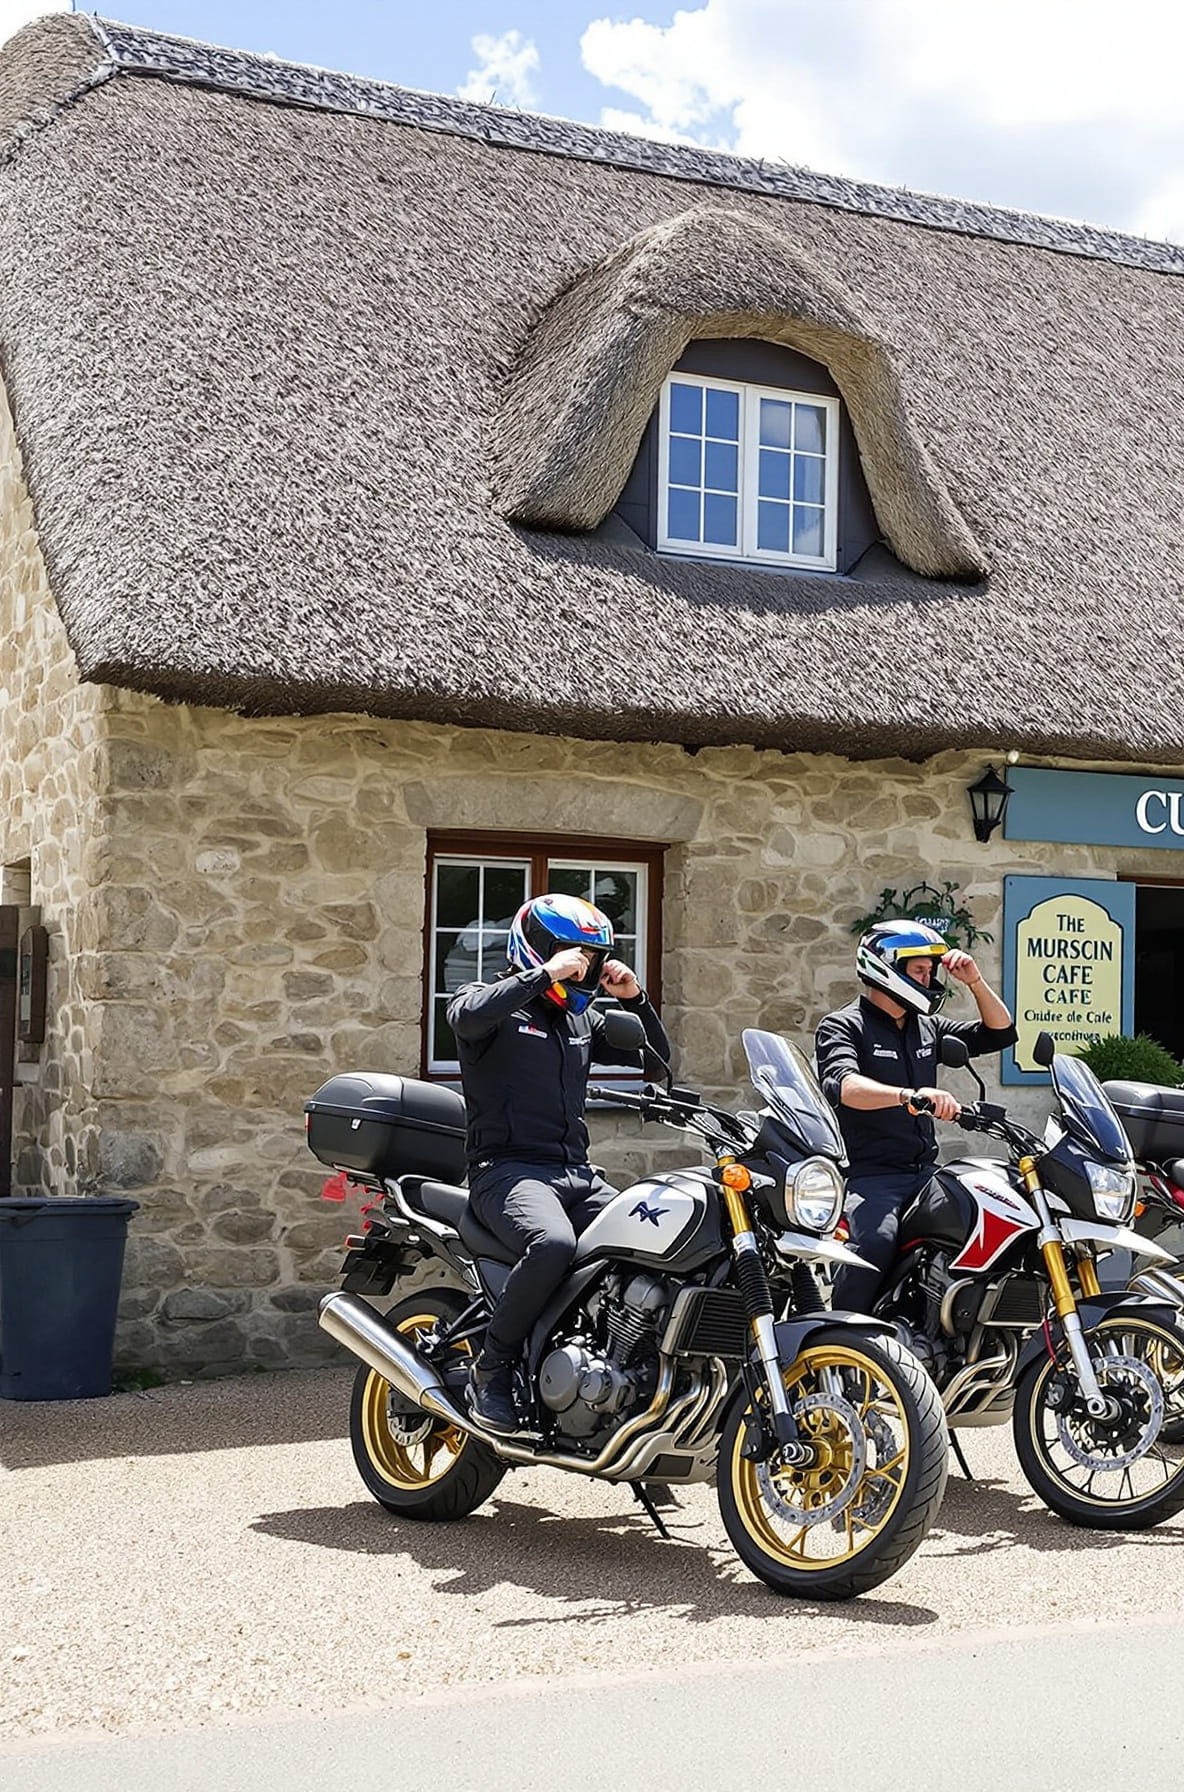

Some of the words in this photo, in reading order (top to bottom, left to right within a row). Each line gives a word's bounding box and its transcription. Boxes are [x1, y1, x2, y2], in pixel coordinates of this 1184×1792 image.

[1056, 914, 1085, 932] THE
[1027, 937, 1113, 961] MURSCIN
[1042, 964, 1093, 985] CAFE
[1044, 988, 1092, 1005] CAFE
